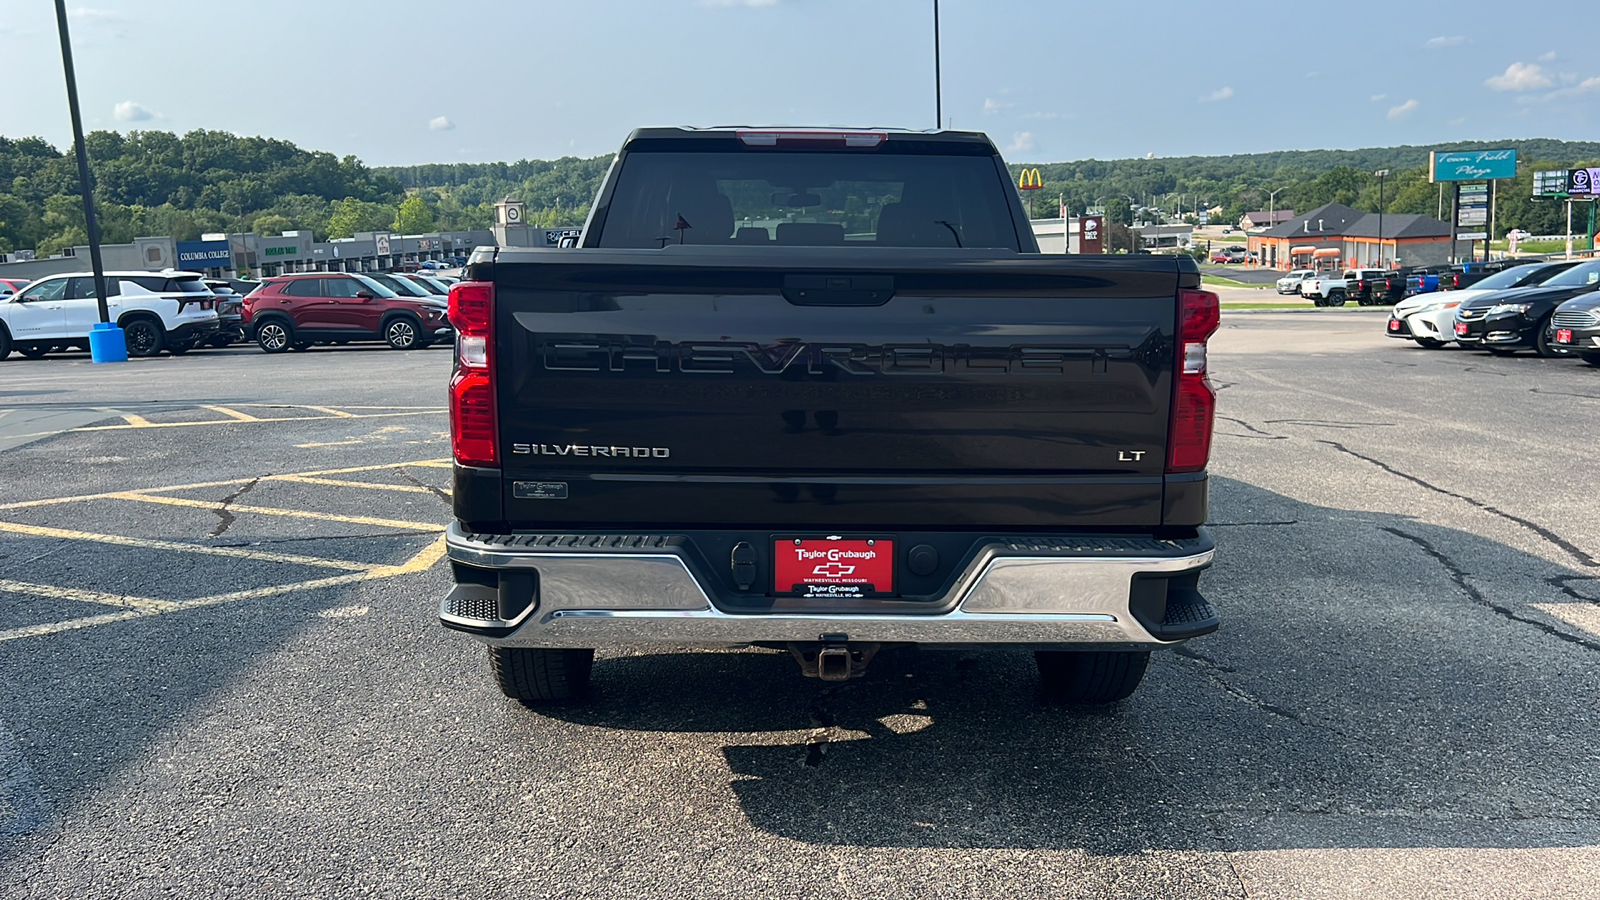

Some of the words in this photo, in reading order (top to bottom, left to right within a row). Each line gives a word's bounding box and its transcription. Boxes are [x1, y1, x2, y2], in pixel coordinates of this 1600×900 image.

[1439, 153, 1471, 163] Town
[1476, 151, 1511, 163] Field
[1455, 165, 1492, 178] Plaza
[180, 251, 208, 261] COLUMBIA
[208, 250, 230, 259] COLLEGE
[543, 341, 1132, 375] CHEVROLET
[512, 443, 671, 458] SILVERADO
[1117, 450, 1146, 461] LT
[795, 549, 827, 561] Taylor
[827, 549, 876, 561] Grubaugh
[807, 585, 828, 593] Taylor
[828, 585, 859, 593] Grubaugh
